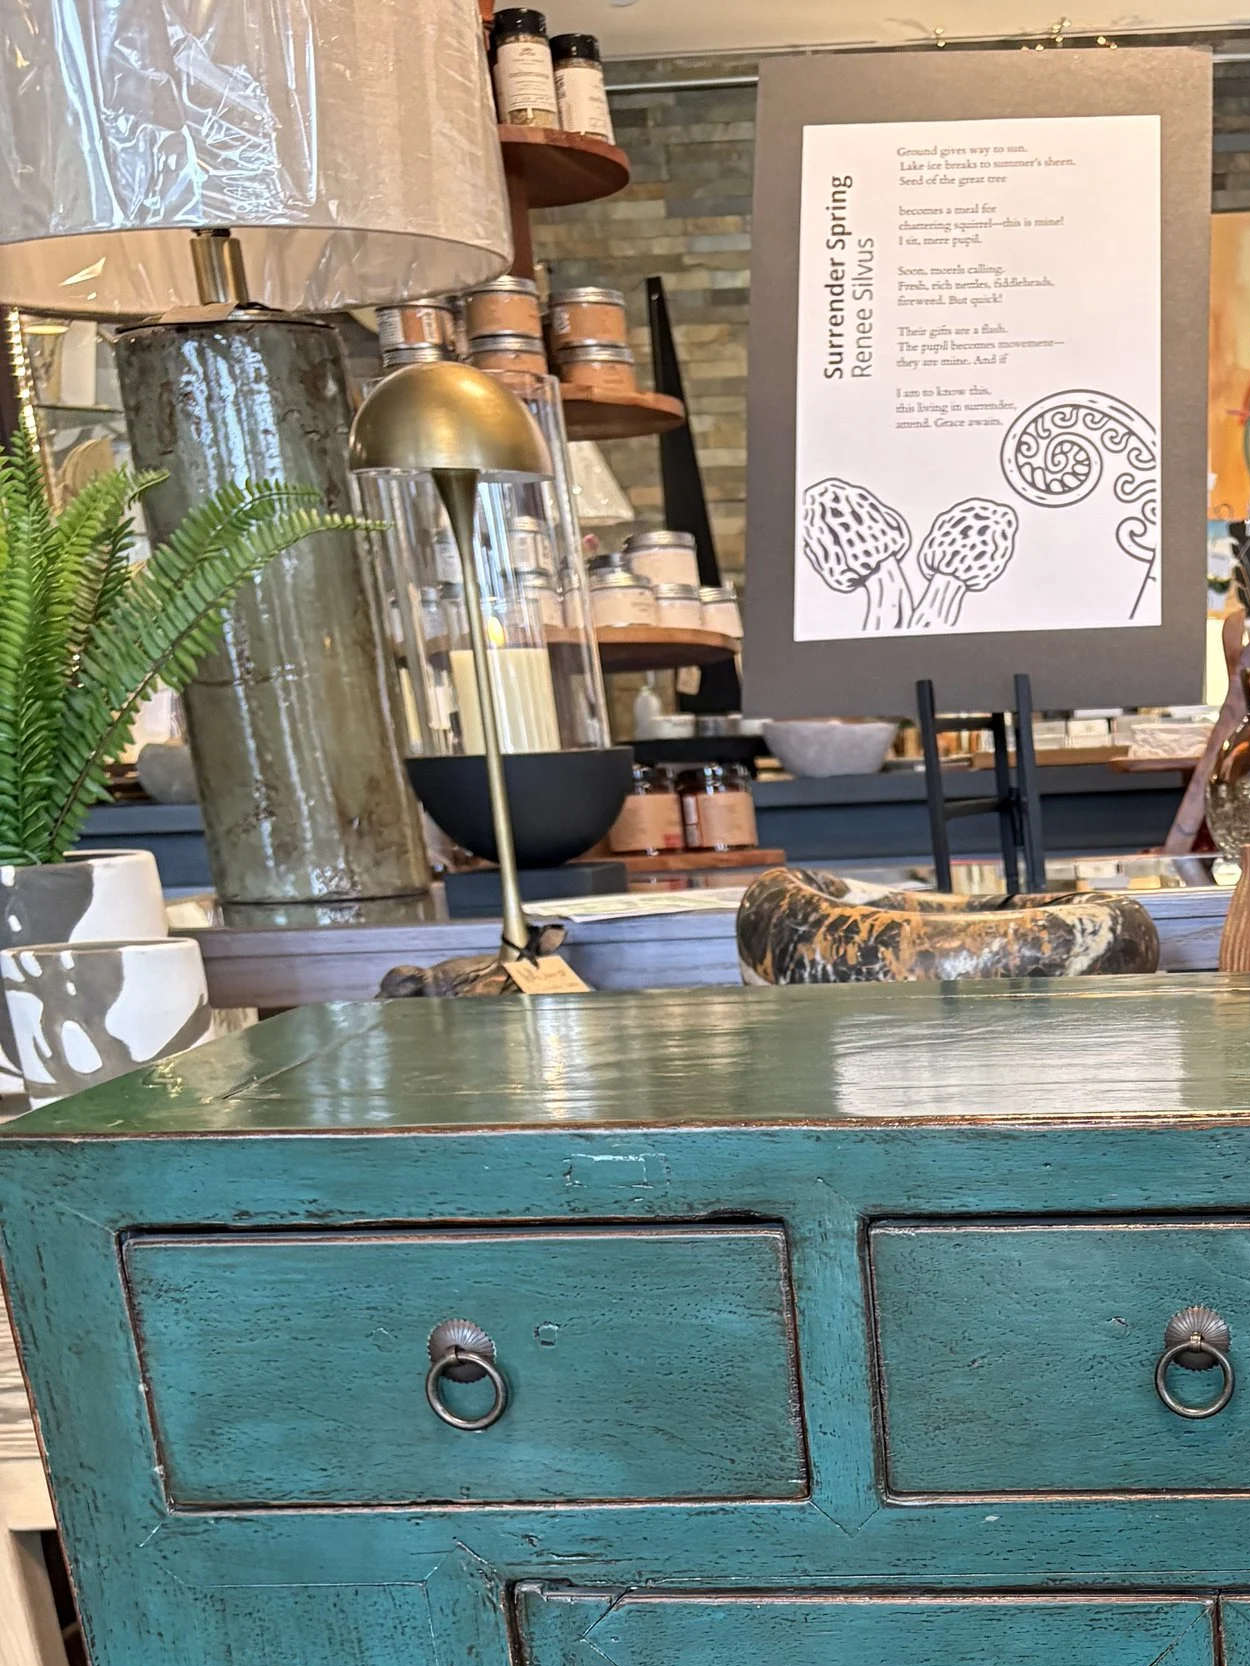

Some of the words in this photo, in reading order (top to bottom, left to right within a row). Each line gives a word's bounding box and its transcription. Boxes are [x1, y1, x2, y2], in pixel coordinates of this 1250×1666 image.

[897, 146, 937, 157] Ground
[940, 146, 966, 158] gives
[969, 147, 990, 156] way
[1007, 145, 1028, 153] sun.
[900, 161, 924, 171] Lake
[927, 161, 942, 170] ice
[945, 160, 977, 170] breaks
[994, 158, 1042, 168] summer's
[1044, 157, 1076, 167] sheen.
[899, 176, 923, 185] Seed
[926, 174, 938, 184] of
[939, 175, 955, 184] the
[958, 176, 984, 187] great
[825, 175, 853, 250] Spring
[899, 206, 943, 216] becomes
[954, 204, 979, 214] meal
[982, 203, 997, 213] for
[1024, 218, 1031, 227] is
[851, 238, 874, 301] Silvus
[932, 280, 952, 290] rich
[949, 296, 968, 305] But
[971, 294, 1003, 307] quick!
[824, 257, 845, 379] Surrender
[898, 327, 926, 336] Their
[955, 327, 970, 335] are
[851, 308, 873, 378] Renee
[898, 342, 919, 351] The
[921, 341, 948, 354] pupil
[951, 341, 995, 350] becomes
[896, 358, 920, 369] they
[974, 355, 996, 365] And
[936, 387, 966, 396] know
[896, 404, 915, 413] this
[951, 403, 961, 411] in
[934, 418, 965, 427] Grace
